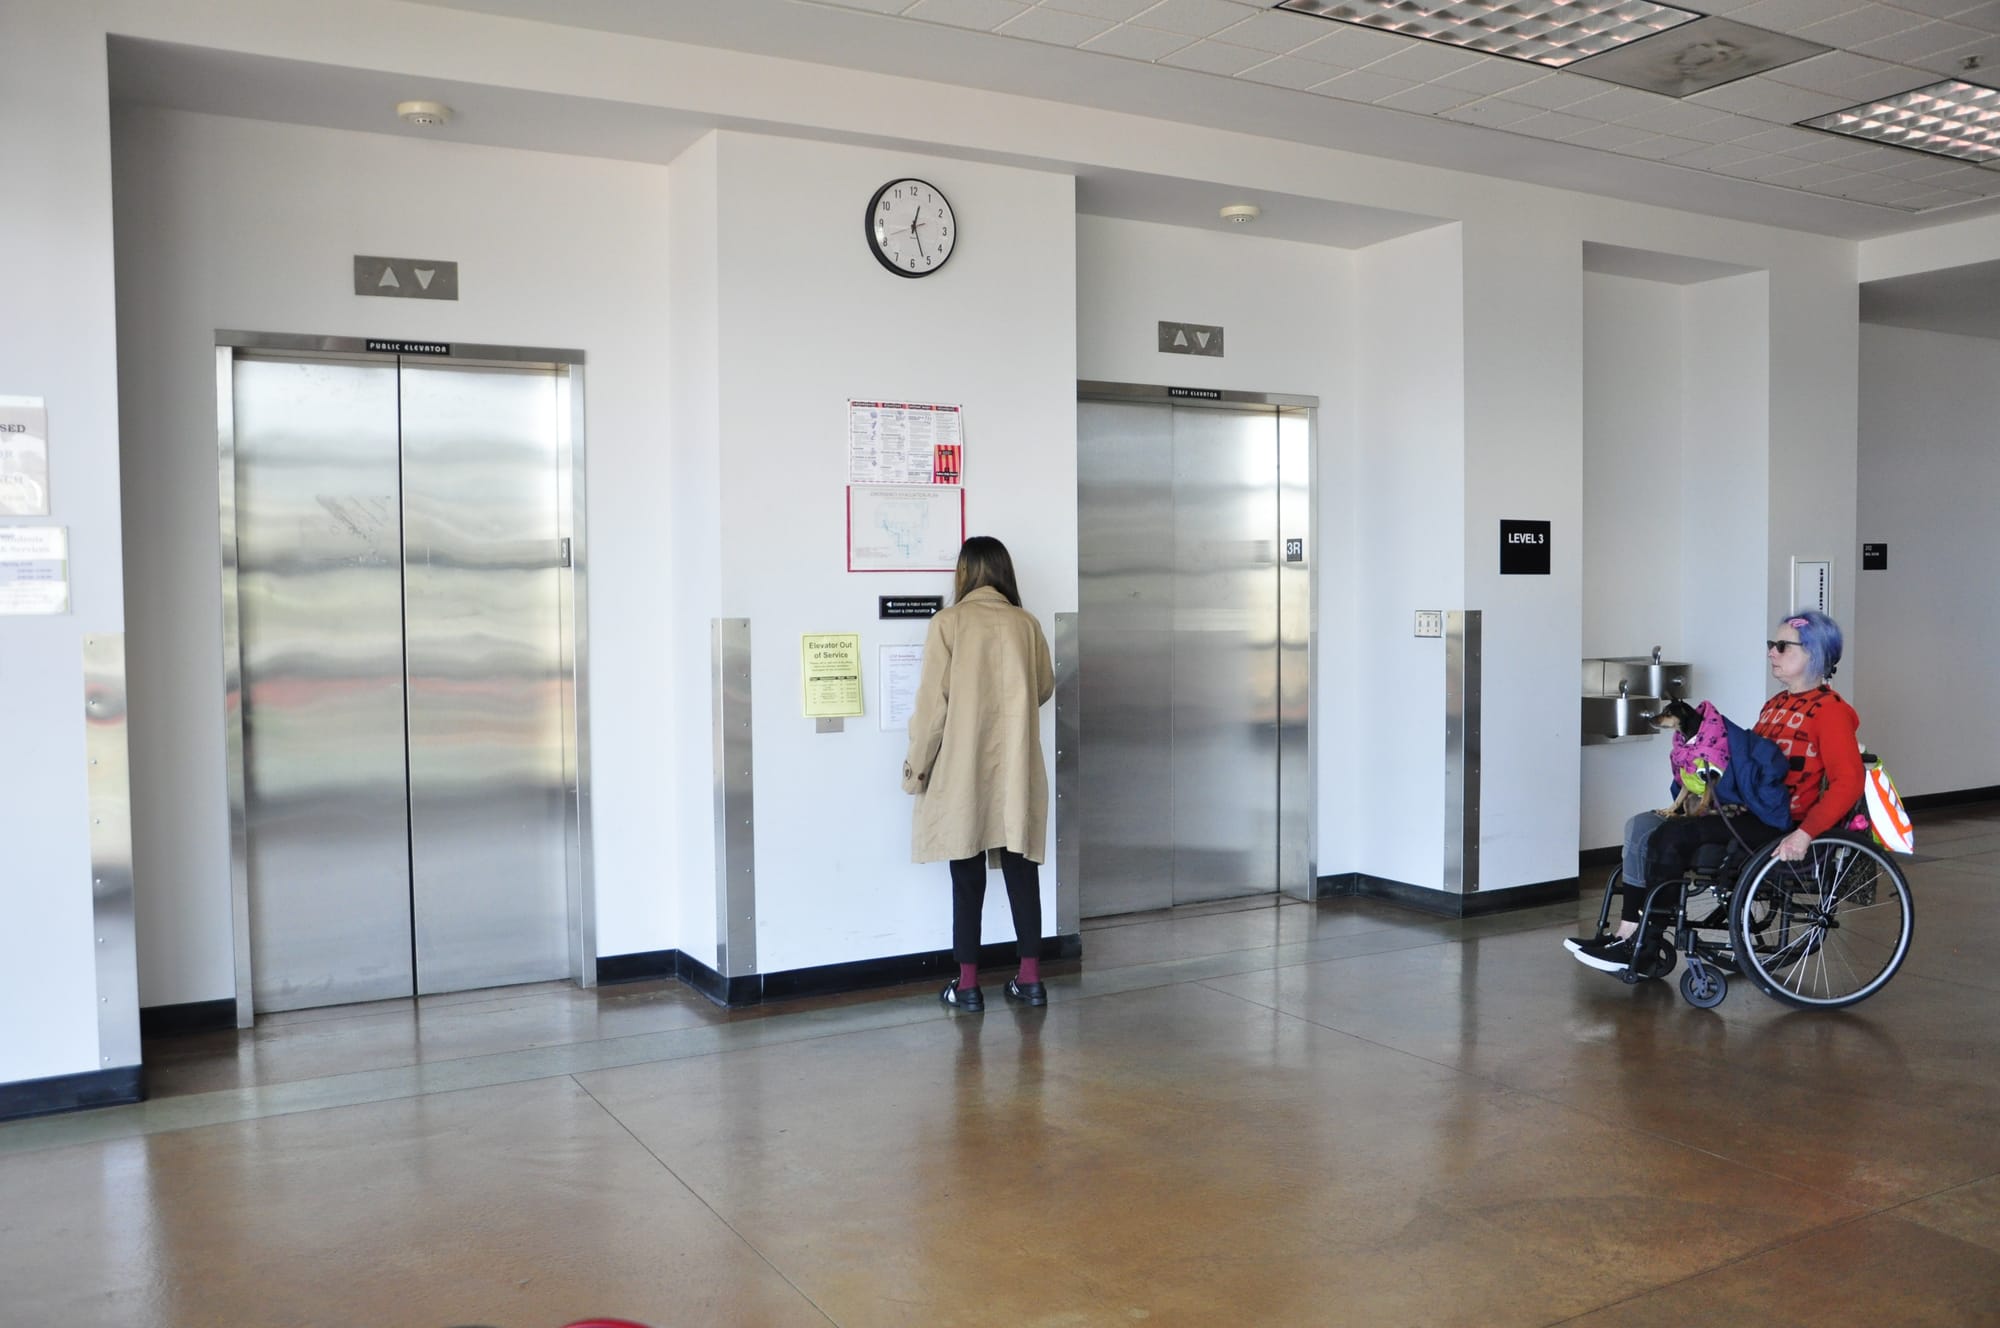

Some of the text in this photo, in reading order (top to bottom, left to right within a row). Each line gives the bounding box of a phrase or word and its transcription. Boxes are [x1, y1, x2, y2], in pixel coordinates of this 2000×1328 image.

[894, 189, 902, 199] 11
[910, 186, 918, 196] 12
[882, 201, 891, 211] 10
[938, 209, 943, 218] 2
[879, 218, 884, 228] 9
[942, 227, 947, 236] 3
[883, 238, 888, 247] 8
[937, 244, 943, 253] 4
[894, 252, 899, 262] 7
[926, 256, 931, 265] 5
[910, 258, 915, 268] 6
[370, 342, 447, 353] PUBLIC ELEVATOR
[1508, 532, 1544, 544] LEVEL 3
[1287, 541, 1301, 555] 3R
[809, 641, 852, 649] Elevator Out
[823, 651, 848, 659] Service
